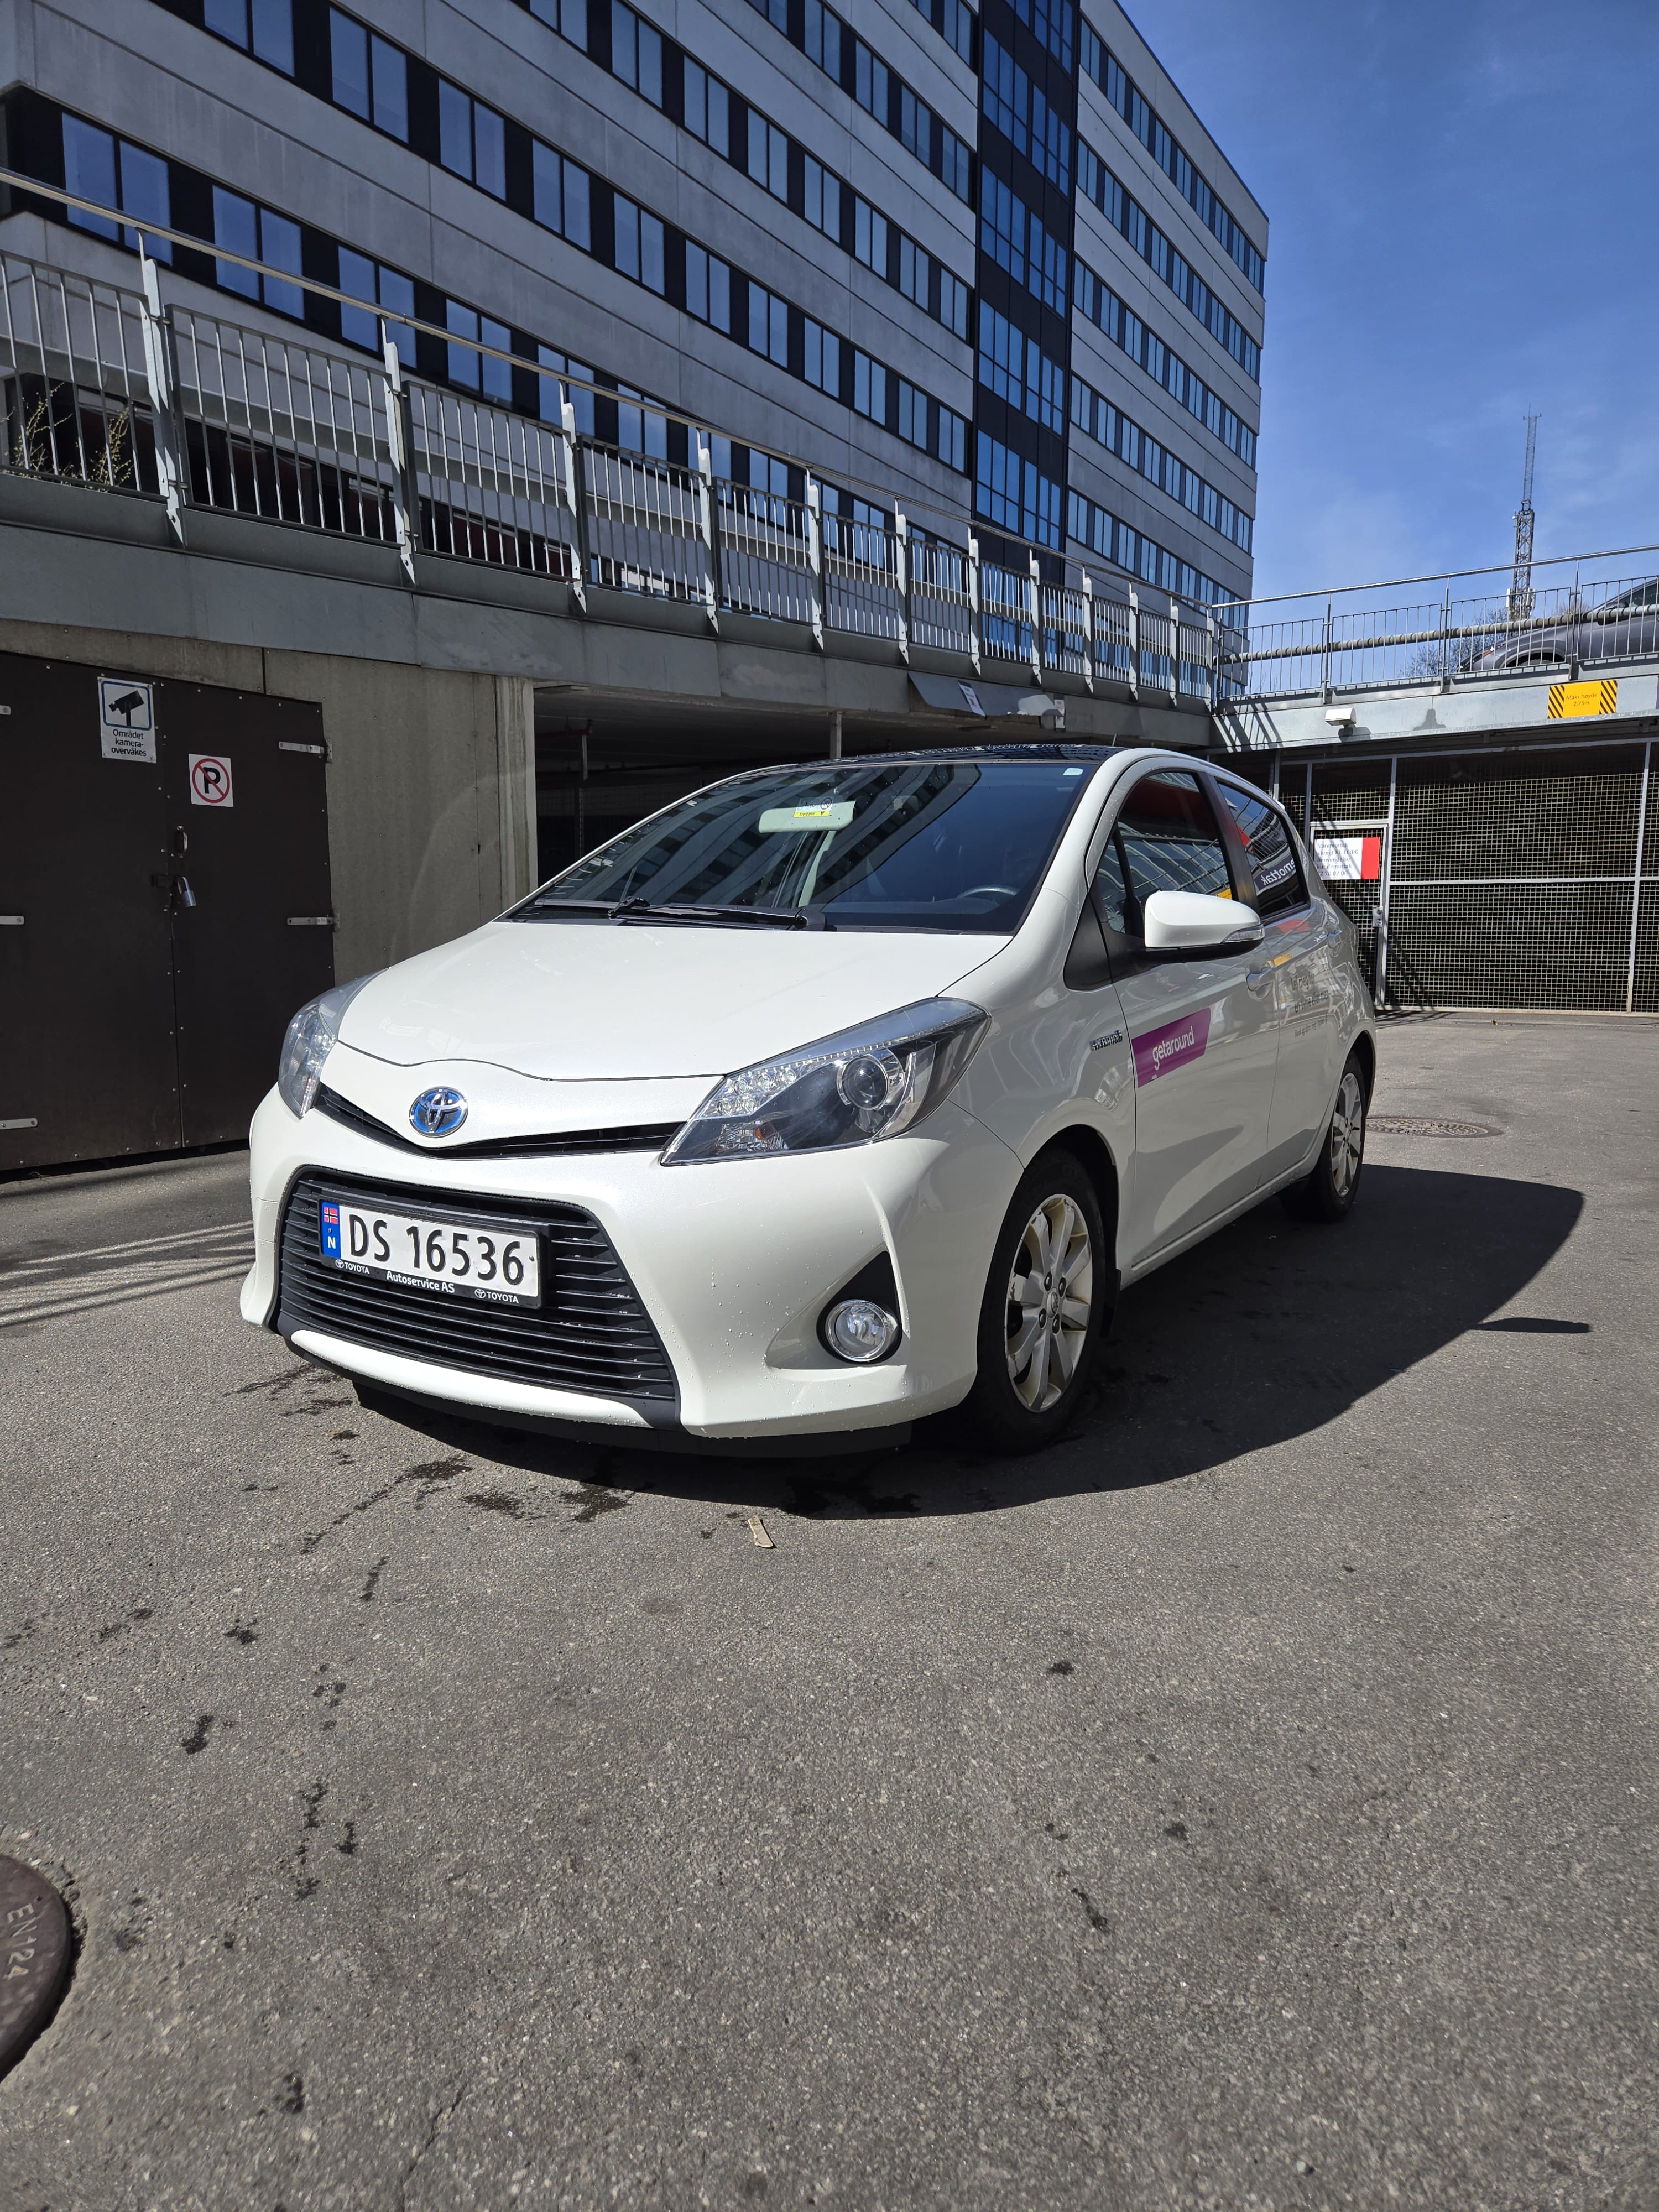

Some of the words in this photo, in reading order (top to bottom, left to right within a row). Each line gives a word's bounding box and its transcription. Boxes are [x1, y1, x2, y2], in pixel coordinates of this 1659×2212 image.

[113, 729, 144, 739] Området
[115, 738, 144, 748] kamera-
[111, 747, 147, 757] overvåkes
[203, 767, 221, 794] P
[1152, 1026, 1194, 1071] getaround
[327, 1236, 336, 1249] N
[349, 1214, 390, 1262] DS
[406, 1225, 524, 1286] 16536
[344, 1262, 370, 1275] TOYOTA
[387, 1271, 440, 1291] Autoservice
[441, 1282, 455, 1293] AS
[487, 1291, 519, 1304] TOYOTA
